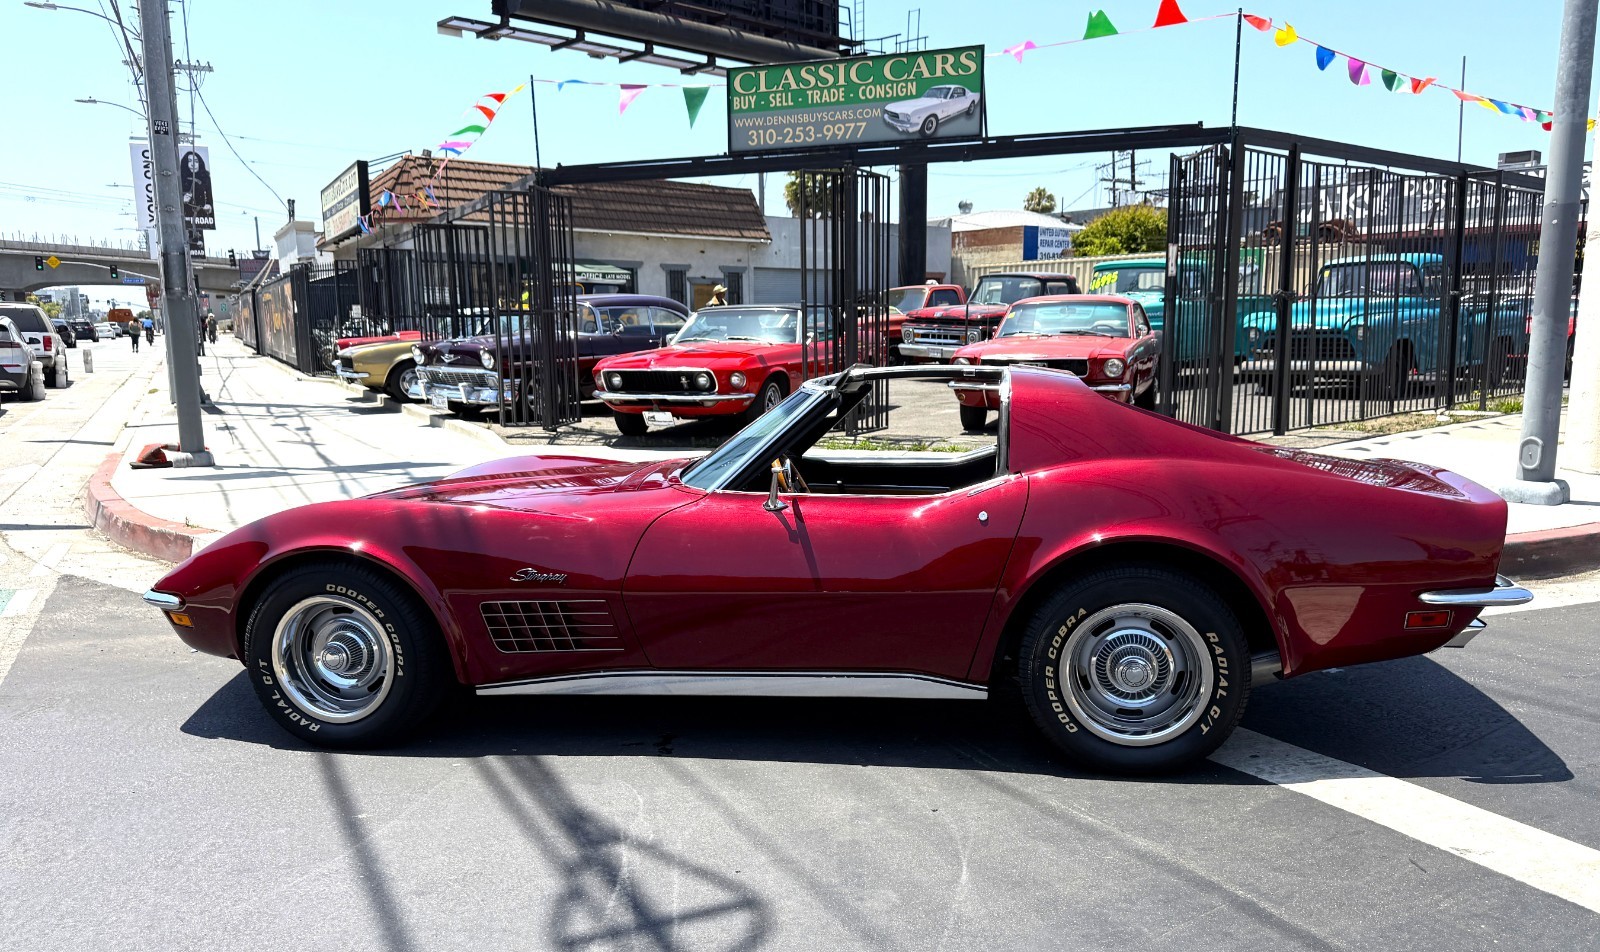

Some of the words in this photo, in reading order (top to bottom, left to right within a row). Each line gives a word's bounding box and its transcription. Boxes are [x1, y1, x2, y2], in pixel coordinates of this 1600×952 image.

[733, 60, 874, 94] CLASSIC
[883, 51, 977, 81] CARS
[733, 95, 757, 110] BUY
[769, 92, 794, 107] SELL
[806, 88, 845, 105] TRADE
[858, 82, 917, 100] CONSIGN
[734, 108, 882, 128] WWW.DENNISBUYSCARS.COM
[748, 122, 867, 146] 310-253-9977
[1039, 228, 1055, 237] UNITED
[1039, 239, 1054, 248] REPAIR
[1054, 240, 1070, 249] CENTER
[509, 567, 568, 584] Stingray
[326, 583, 386, 619] COOPER
[385, 623, 405, 677] COBRA
[1047, 607, 1088, 660] COBRA
[258, 658, 274, 686] G/T
[1205, 632, 1229, 700] RADIAL
[271, 689, 321, 733] RADIAL
[1045, 665, 1079, 734] COOPER
[1199, 704, 1222, 735] G/T
